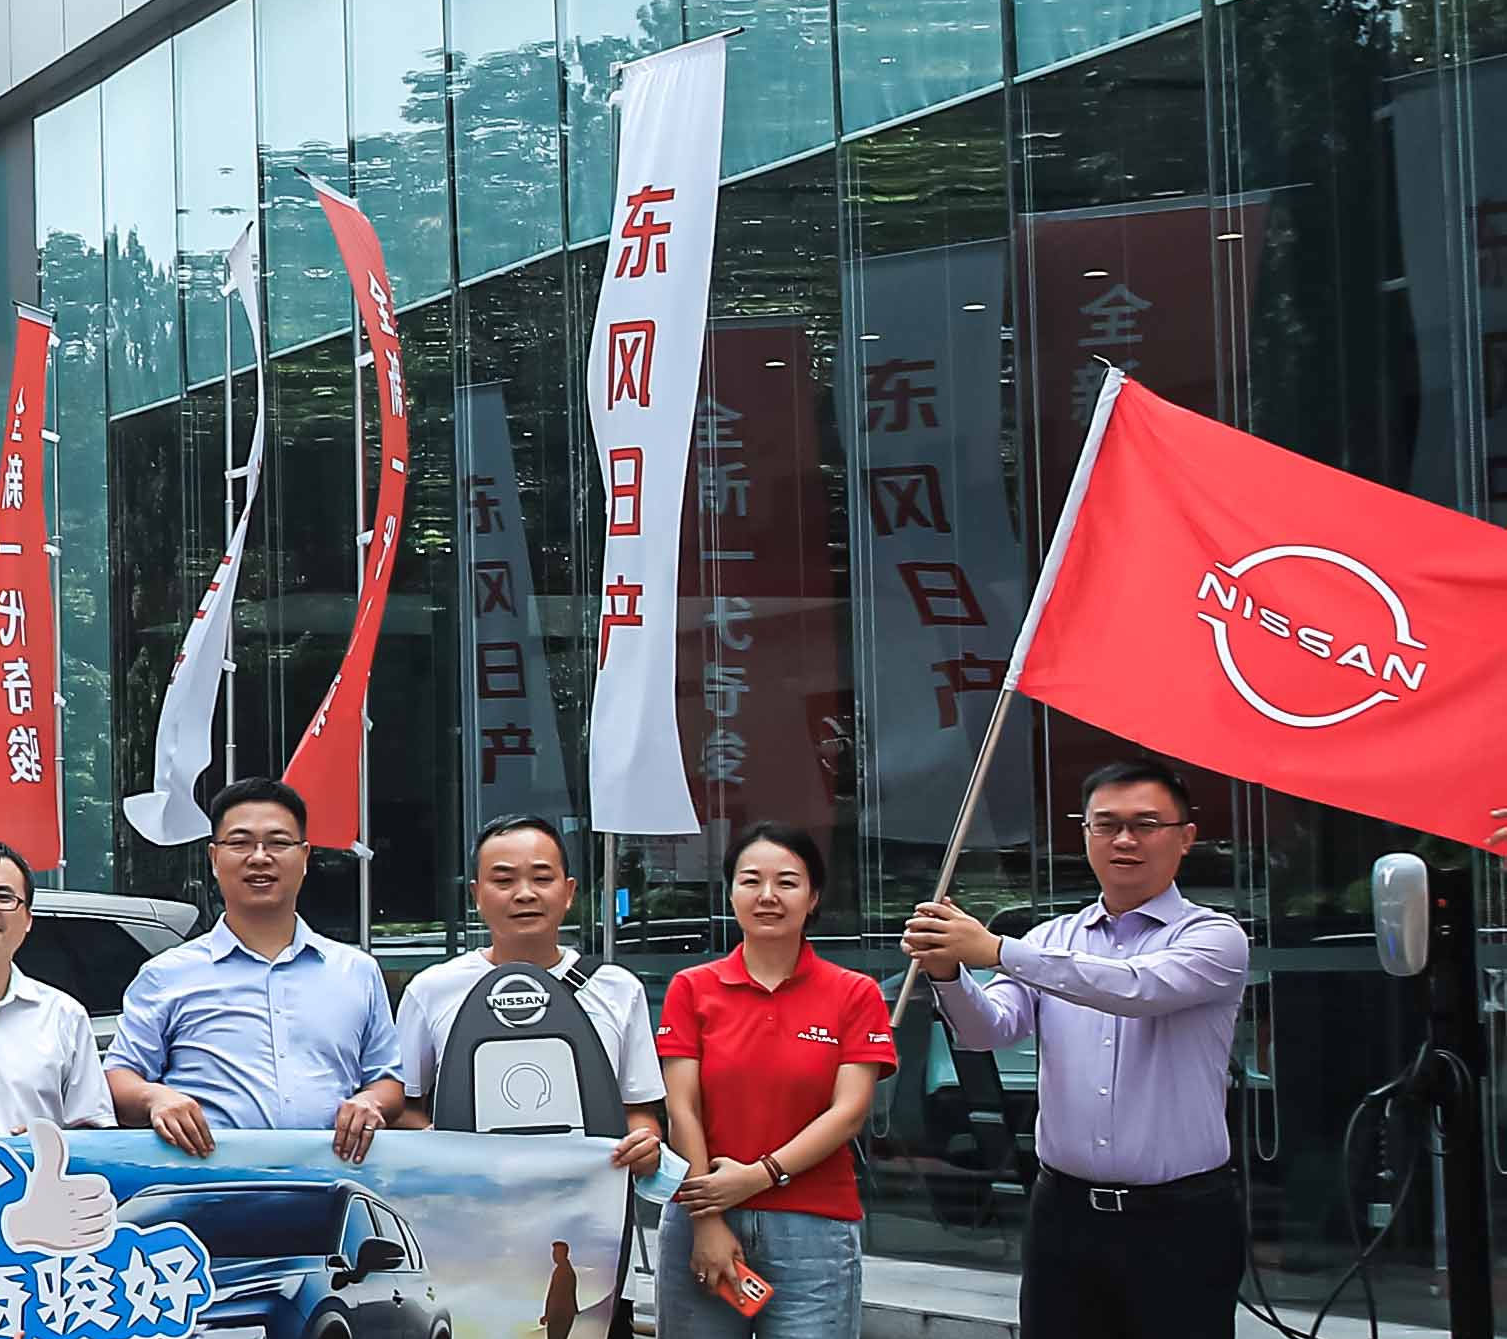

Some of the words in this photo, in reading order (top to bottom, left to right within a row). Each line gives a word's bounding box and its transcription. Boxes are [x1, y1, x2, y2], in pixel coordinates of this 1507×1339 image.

[599, 184, 677, 672] 东风日产
[1197, 573, 1427, 691] NISSAN
[491, 996, 546, 1007] NISSAN
